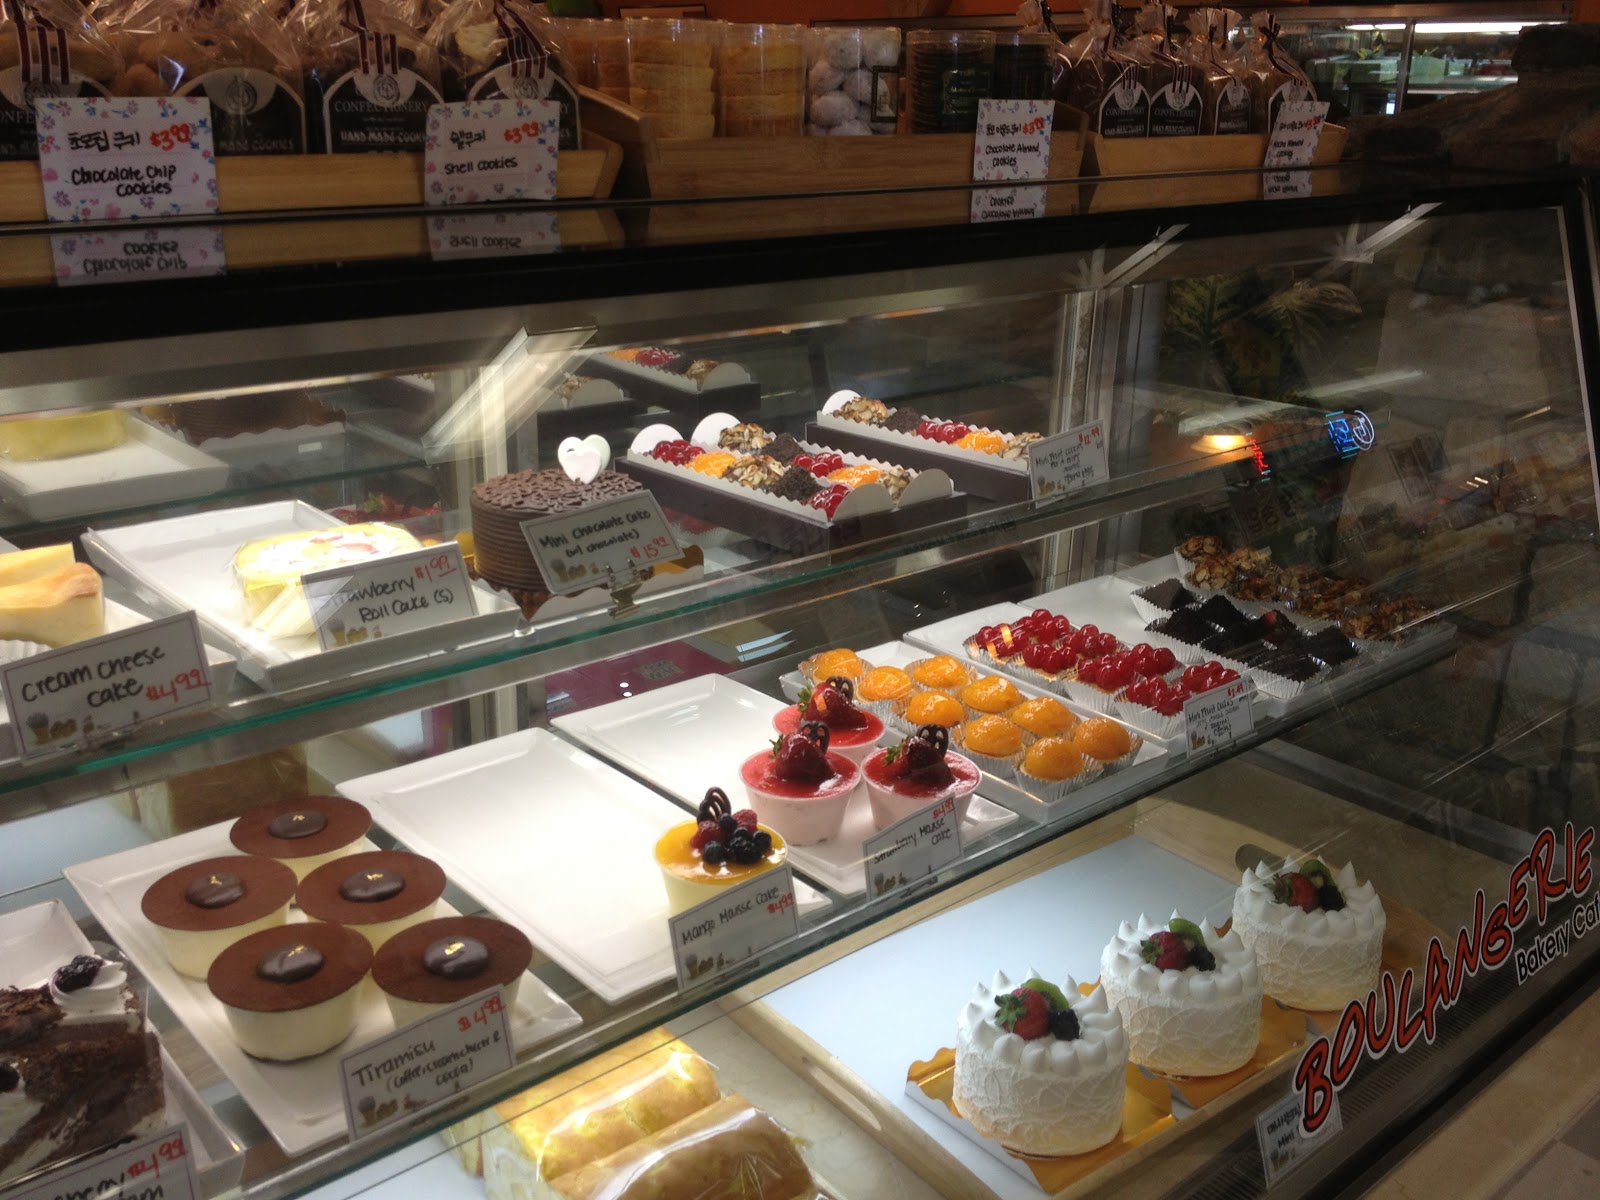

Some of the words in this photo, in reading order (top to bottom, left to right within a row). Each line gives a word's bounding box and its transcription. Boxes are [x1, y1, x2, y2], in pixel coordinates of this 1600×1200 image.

[71, 164, 144, 186] Chocolate
[146, 164, 177, 180] Chip
[539, 533, 570, 550] Mini
[682, 918, 716, 945] Mango
[1514, 918, 1571, 987] Bakery
[1292, 821, 1595, 1139] BOULANGERIE
[351, 1040, 436, 1088] Tiramisu
